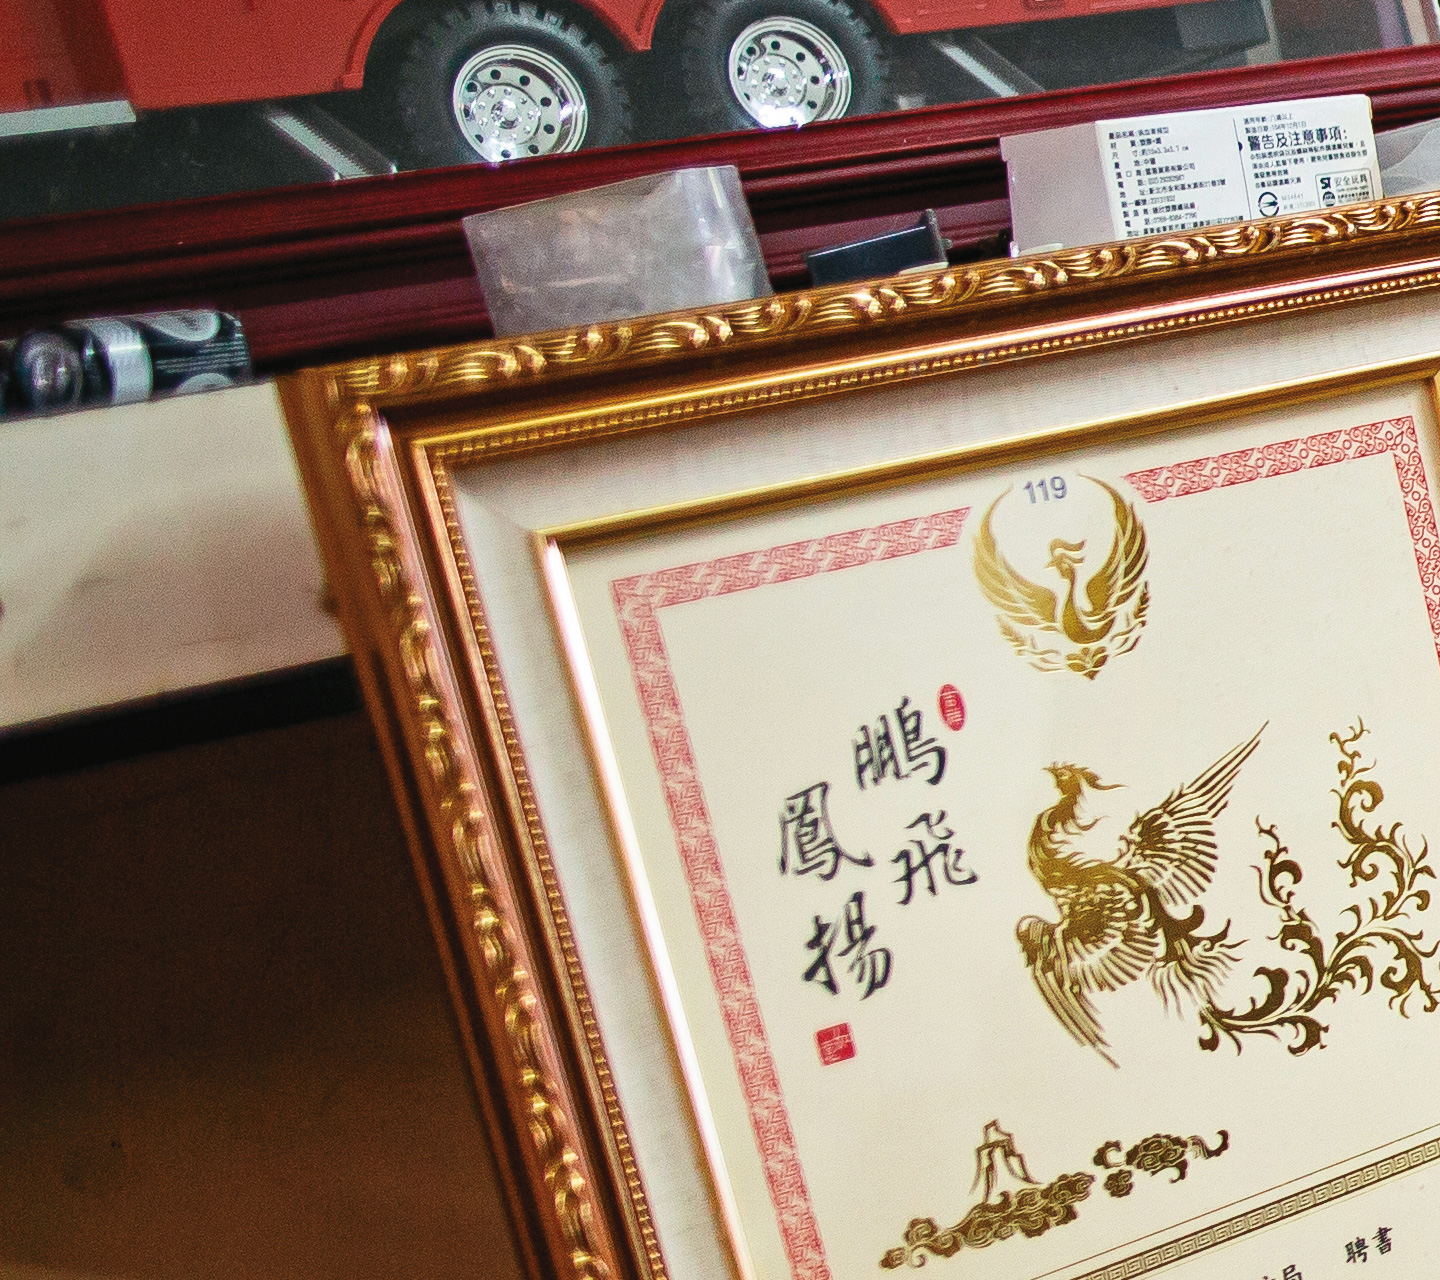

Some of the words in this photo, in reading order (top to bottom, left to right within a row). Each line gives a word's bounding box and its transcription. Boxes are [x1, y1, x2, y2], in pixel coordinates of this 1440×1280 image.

[1023, 476, 1067, 504] 119
[853, 696, 978, 906] 鵬飛
[779, 781, 895, 1001] 鳳揚
[1344, 1226, 1393, 1264] 聘書
